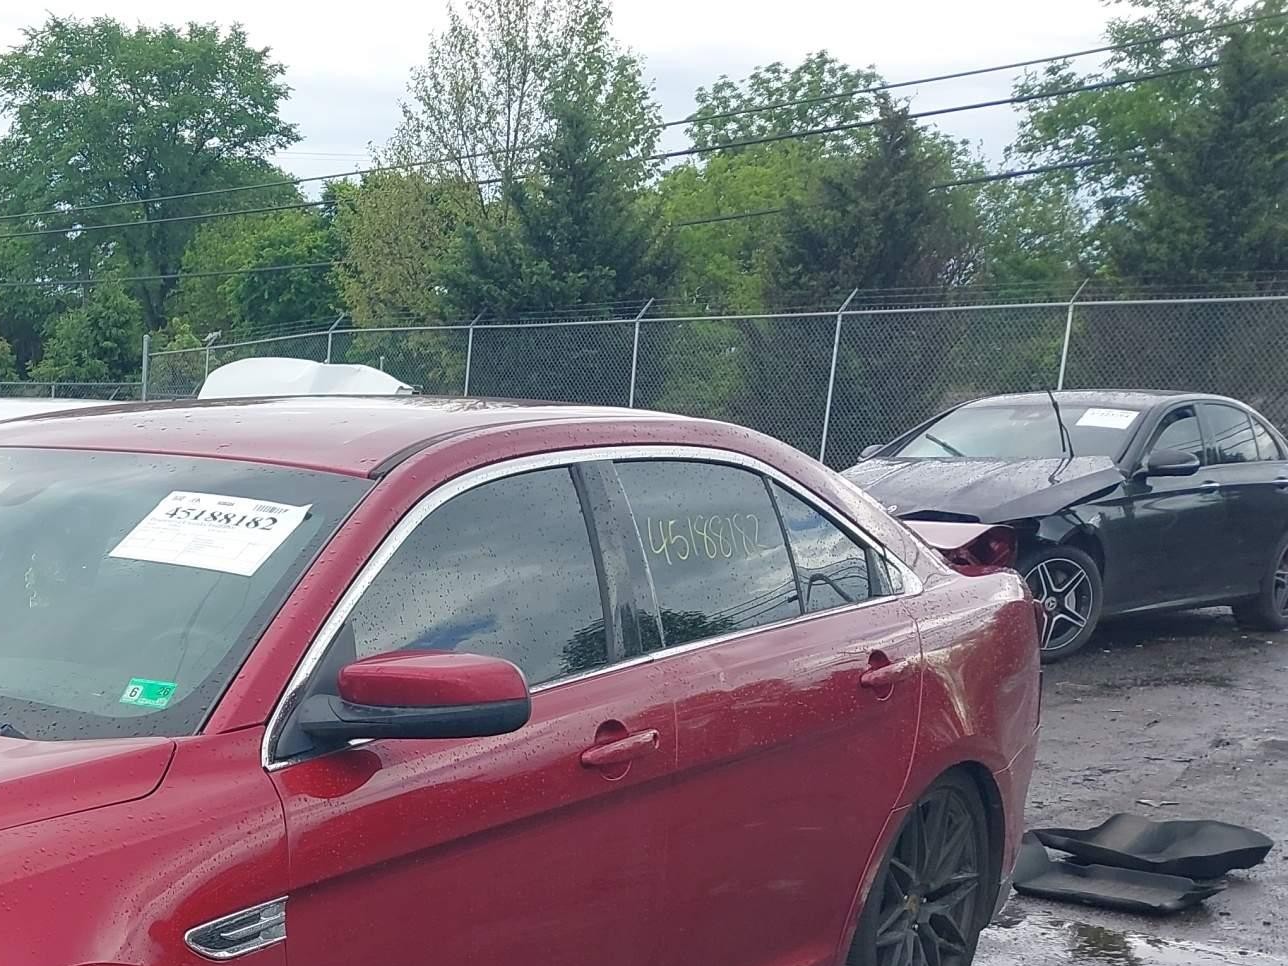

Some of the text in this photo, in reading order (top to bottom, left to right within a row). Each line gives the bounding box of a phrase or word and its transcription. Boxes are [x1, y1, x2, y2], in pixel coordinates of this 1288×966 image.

[165, 506, 278, 531] 45188182
[647, 512, 768, 566] 45188182
[128, 687, 140, 698] 6
